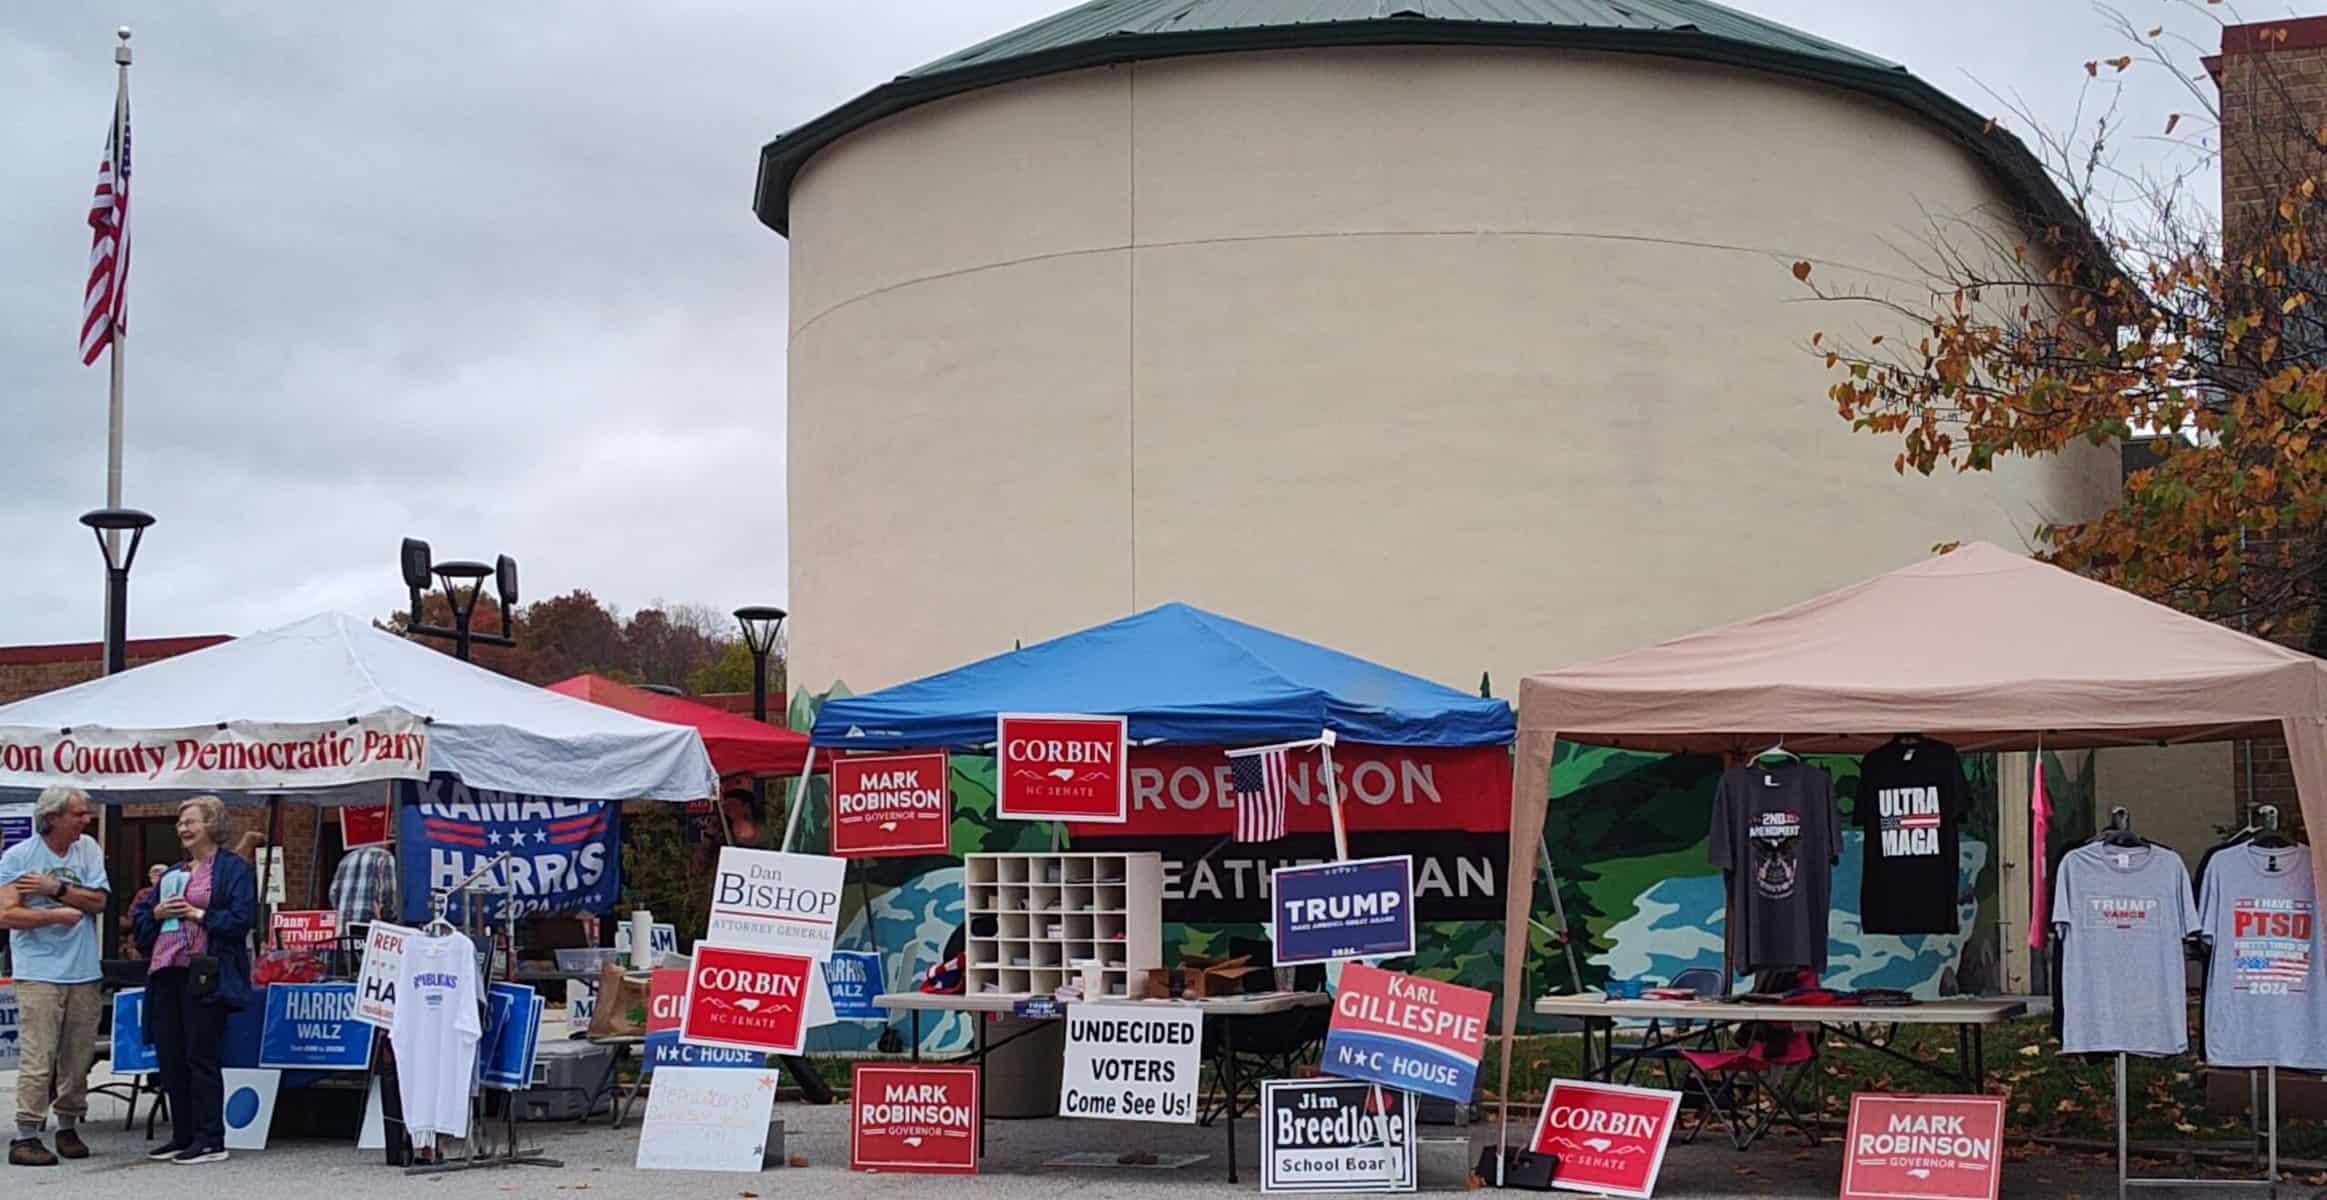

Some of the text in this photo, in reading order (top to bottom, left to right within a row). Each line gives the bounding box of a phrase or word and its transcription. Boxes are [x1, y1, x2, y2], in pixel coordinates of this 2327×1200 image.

[53, 739, 167, 780] County
[175, 731, 355, 771] Democratic
[1008, 739, 1114, 764] CORBIN
[861, 769, 919, 791] MARK
[1026, 786, 1095, 798] NC SENATE
[1130, 760, 1441, 811] ROBNSON
[417, 778, 605, 822] KAMAL
[839, 788, 941, 815] ROBINSON
[1879, 786, 1940, 817] ULTRA
[864, 811, 915, 822] GOVERNOR
[1881, 828, 1940, 857] MAGA
[430, 842, 606, 897] HARRIS
[750, 863, 782, 881] Dan
[716, 871, 837, 914] BISHOP
[2091, 898, 2158, 912] TRUMP
[1285, 891, 1400, 923] TRUMP
[274, 914, 311, 929] Danny
[776, 924, 832, 941] GENERAL
[2234, 910, 2313, 940] PTSD
[698, 966, 802, 998] CORBIN
[1387, 975, 1440, 1006] KARL
[285, 991, 356, 1021] HARRIS
[1339, 991, 1481, 1044] GILLESPIE
[297, 1023, 342, 1039] WALZ
[710, 1013, 776, 1029] NC SENATE
[1070, 1019, 1195, 1045] UNDECIDED
[701, 1045, 753, 1063] HOUSE
[1091, 1058, 1176, 1083] VOTERS
[1391, 1055, 1460, 1087] HOUSE
[884, 1084, 948, 1104] MARK
[1066, 1089, 1193, 1117] Come See Us!
[1297, 1092, 1339, 1109] Jim
[862, 1103, 970, 1128] ROBINSON
[1277, 1104, 1403, 1145] Breedlove
[1550, 1105, 1661, 1139] CORBIN
[1887, 1113, 1966, 1135] MARK
[888, 1126, 942, 1137] GOVERNOR
[1857, 1133, 1991, 1161] ROBINSON
[1281, 1157, 1340, 1173] School
[1578, 1154, 1626, 1170] SENATE
[1889, 1156, 1955, 1169] GOVERNOR
